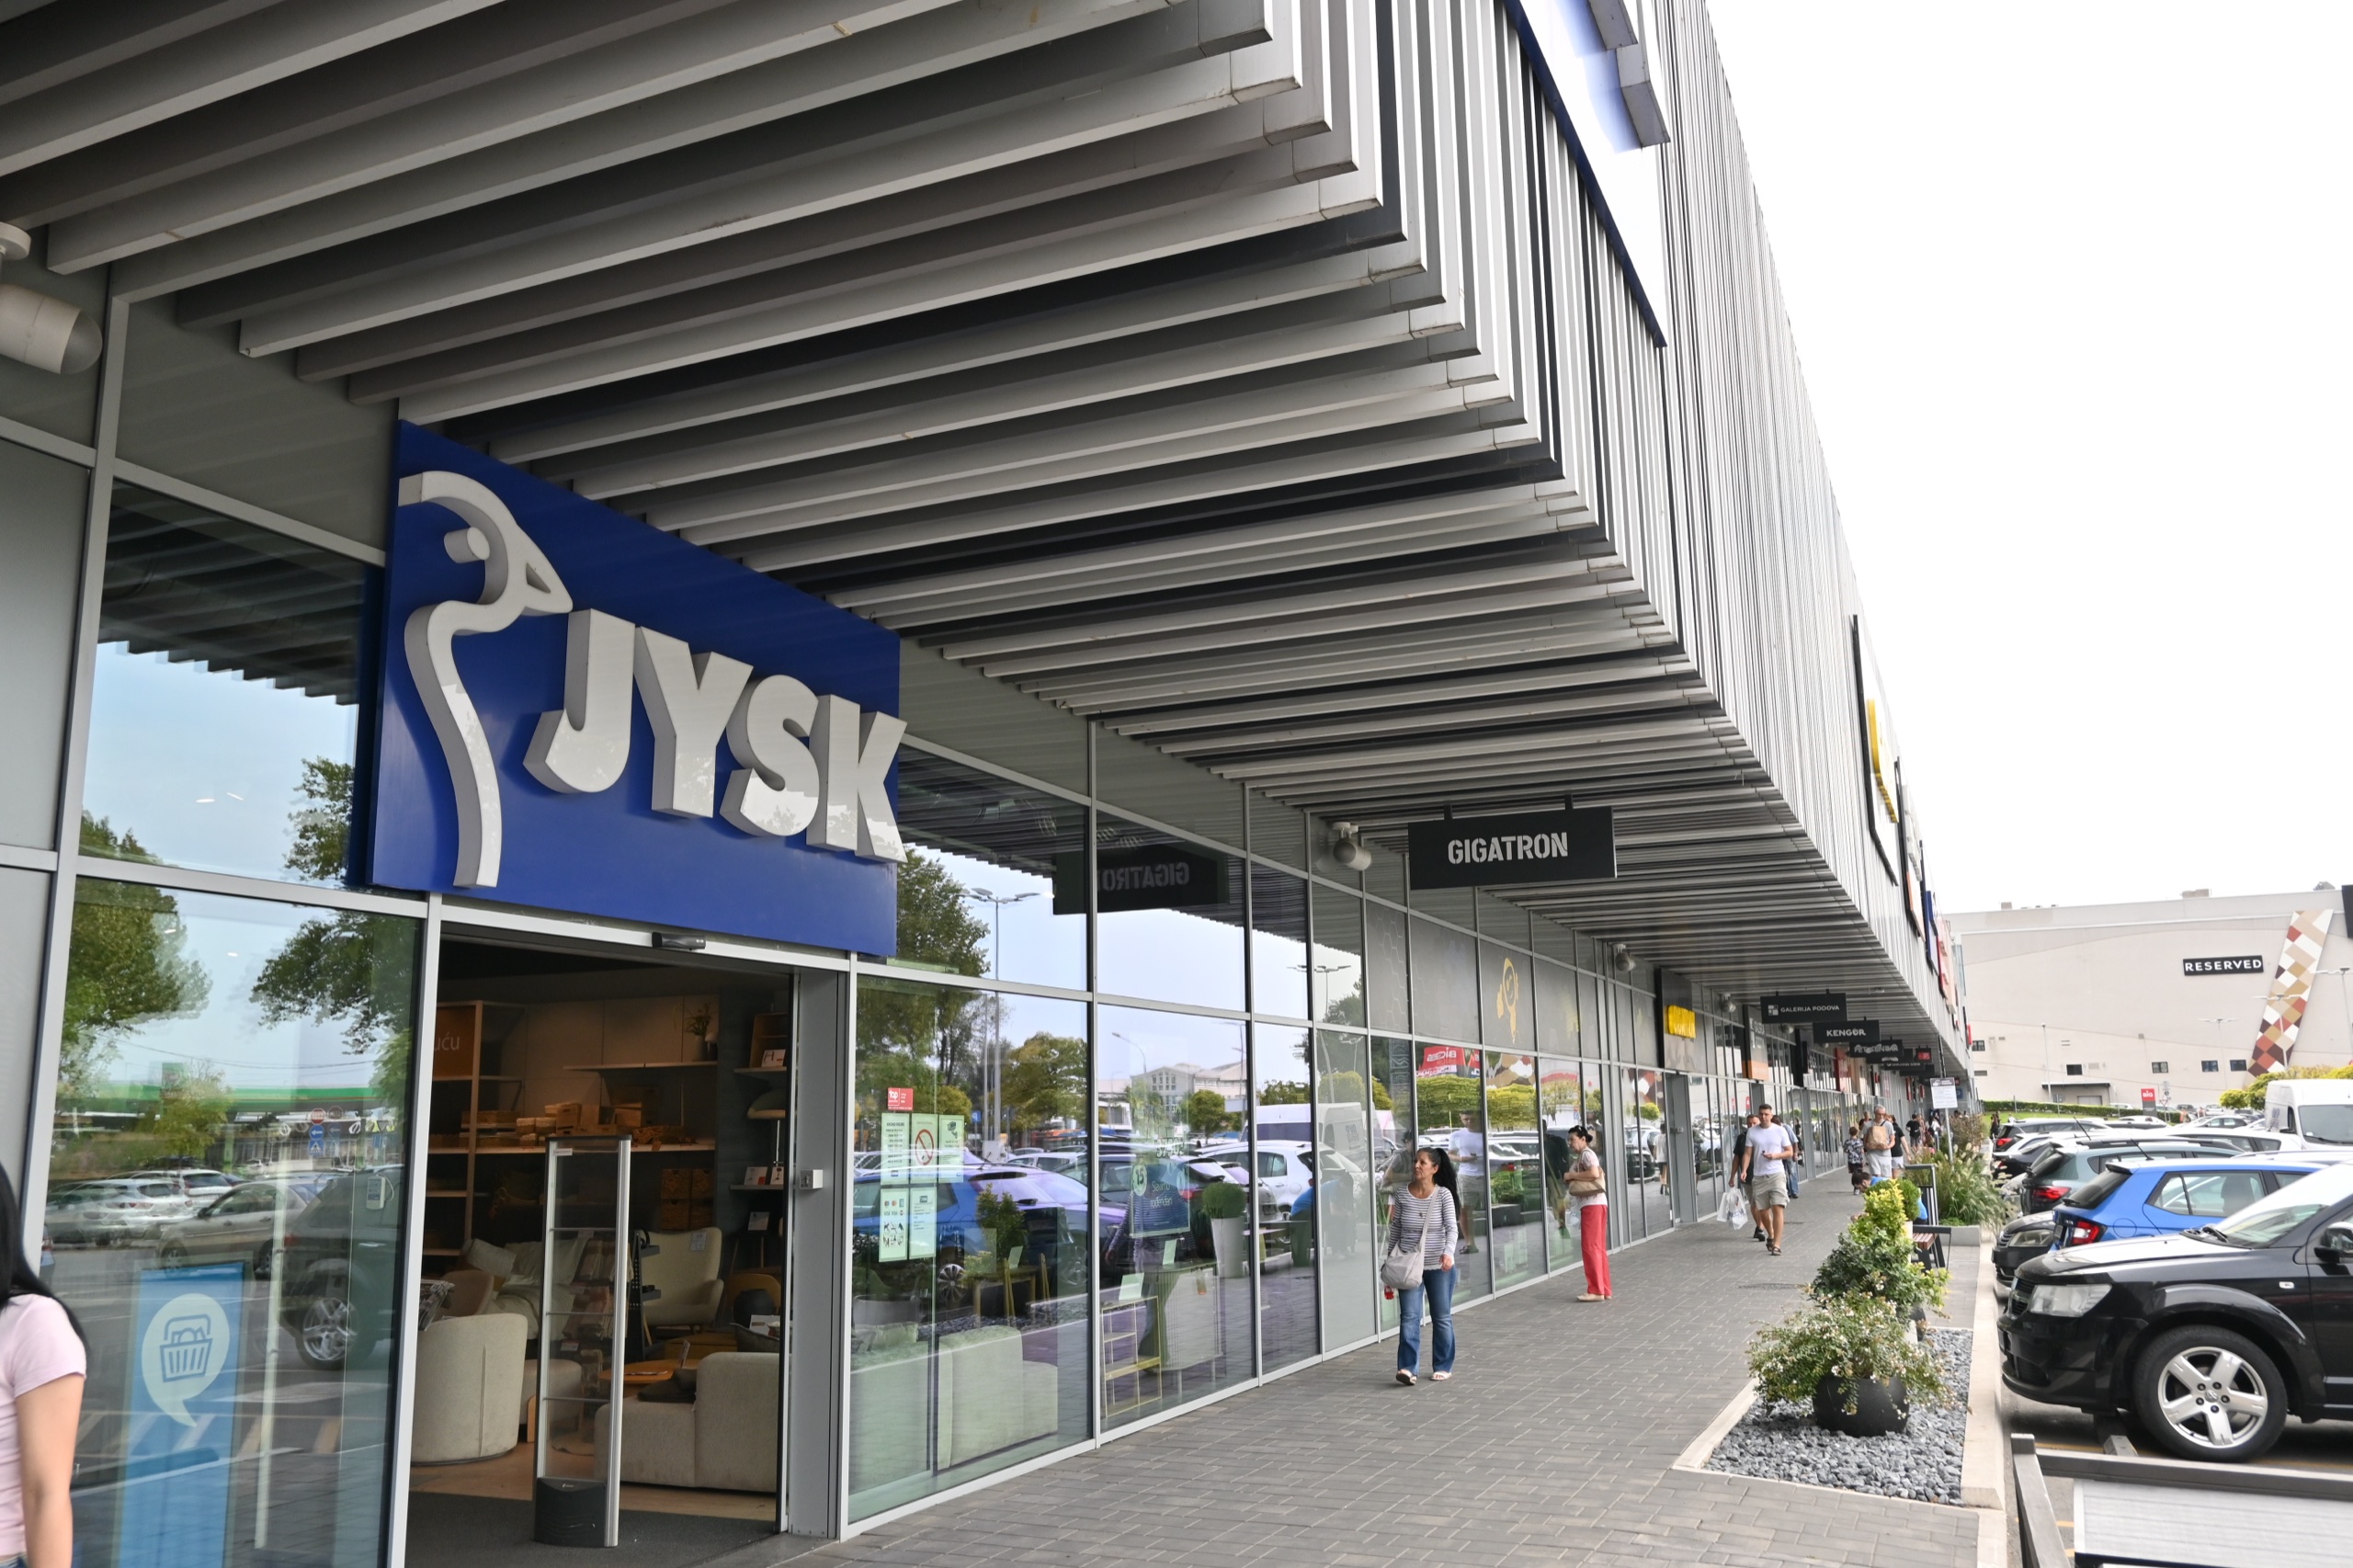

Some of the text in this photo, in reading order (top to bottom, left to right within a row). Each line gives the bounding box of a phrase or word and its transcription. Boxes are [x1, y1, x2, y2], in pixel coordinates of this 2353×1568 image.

[523, 608, 908, 864] JYSK
[1448, 832, 1568, 865] GIGATRON
[2185, 959, 2262, 972] RESERVED
